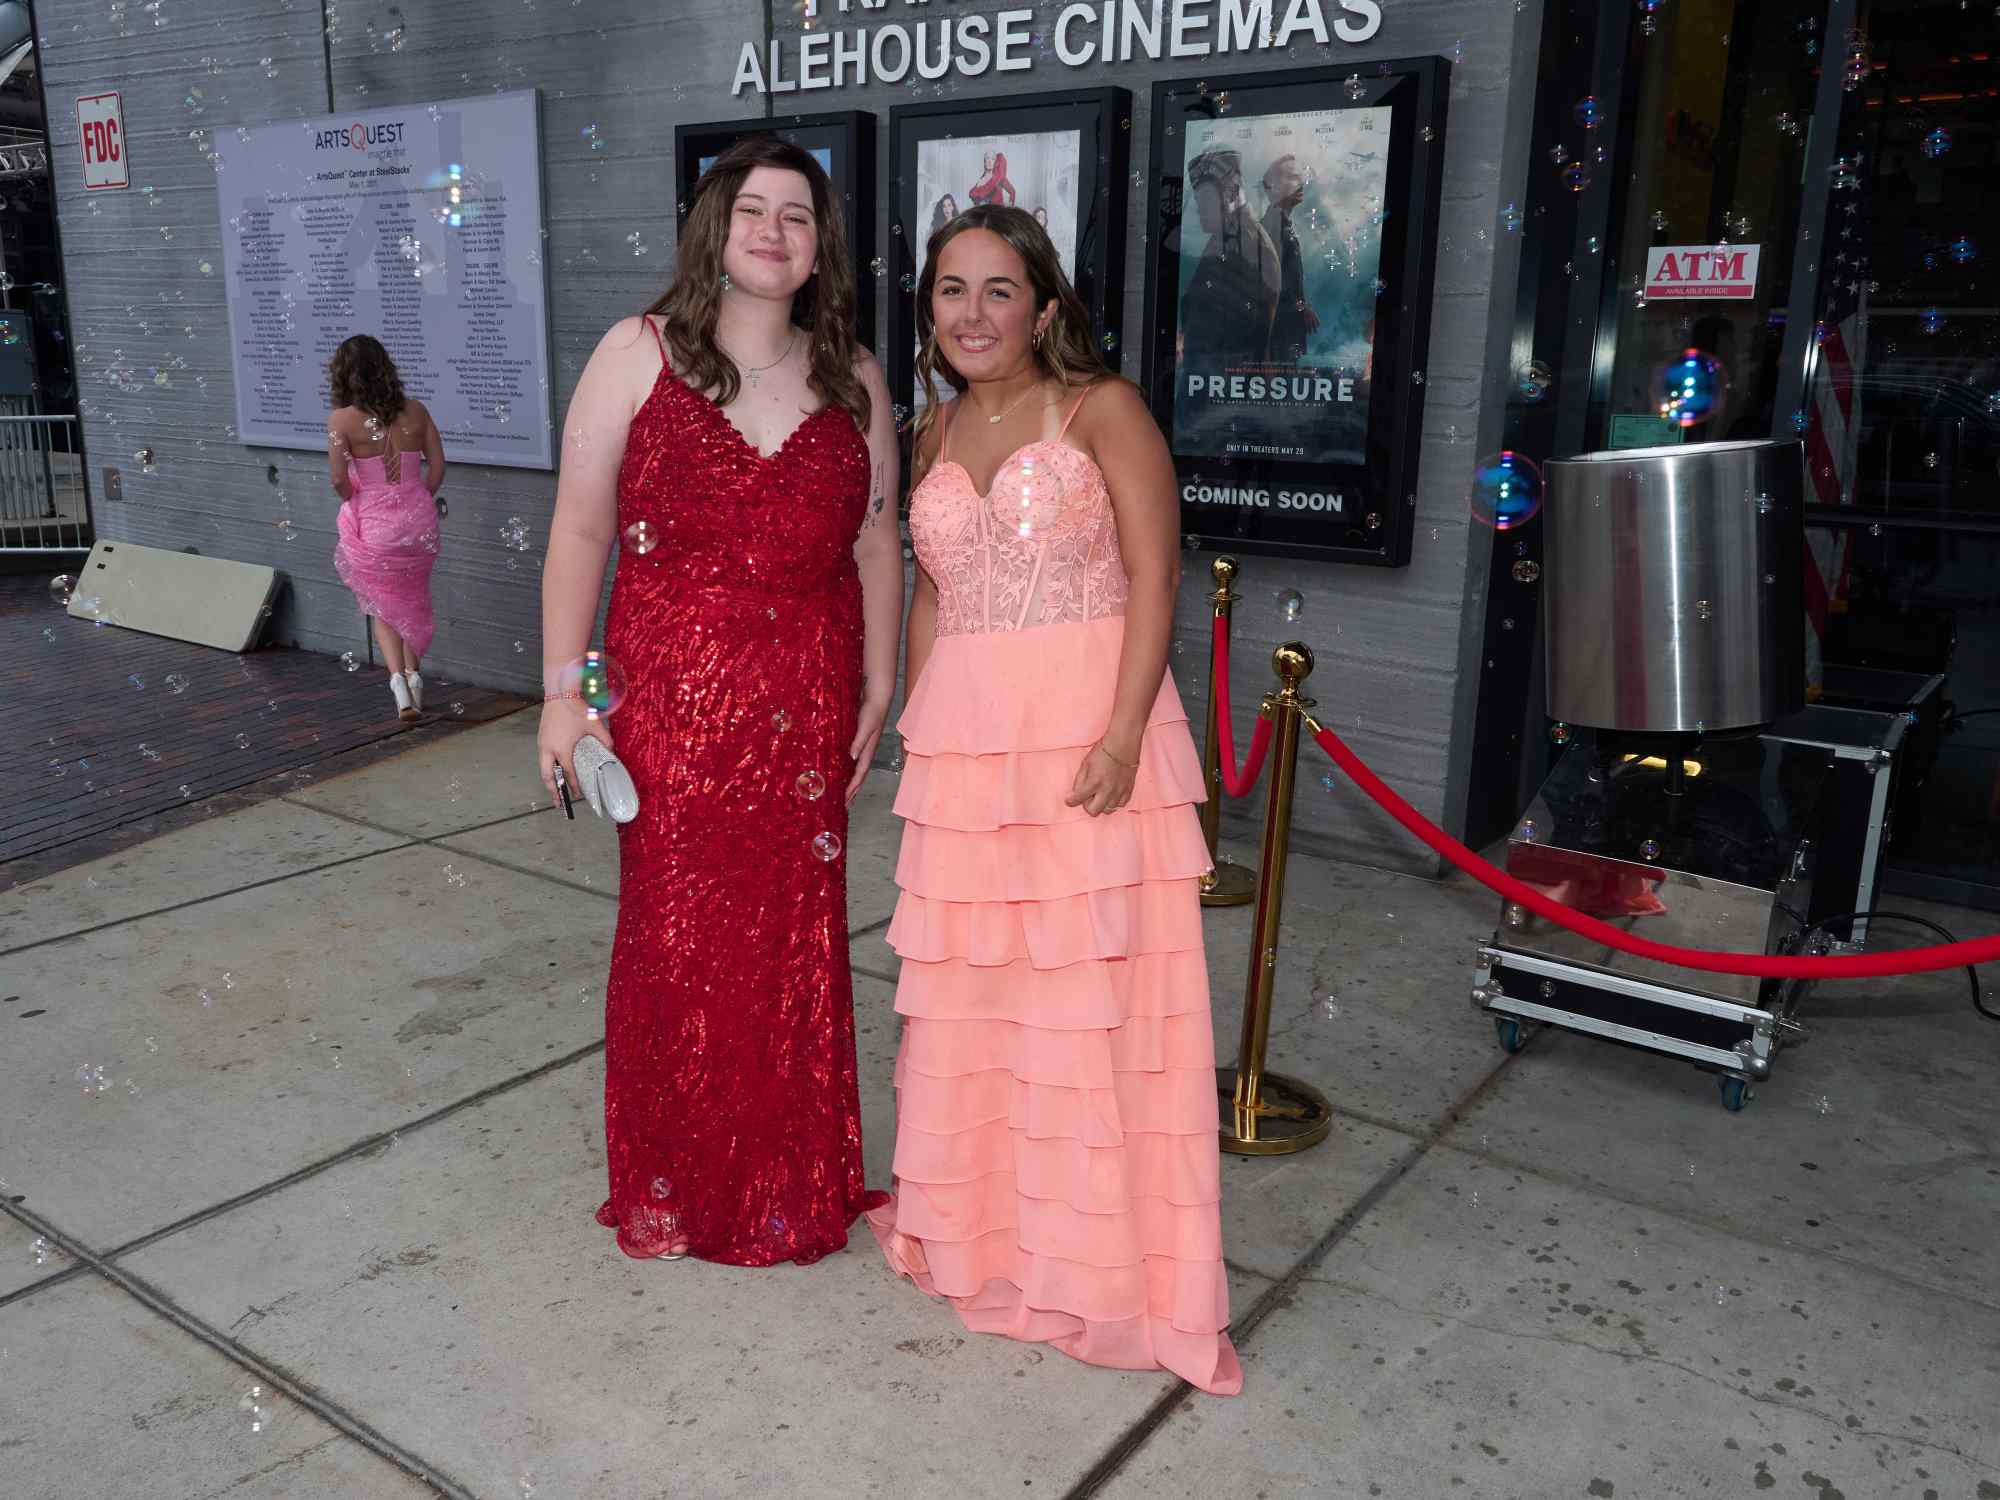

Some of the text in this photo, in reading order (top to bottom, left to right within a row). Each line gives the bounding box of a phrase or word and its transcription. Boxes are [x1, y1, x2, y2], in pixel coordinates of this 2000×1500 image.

[732, 0, 1383, 96] ALEHOUSE CINEMAS
[83, 118, 120, 164] FDC
[315, 122, 405, 151] ARTSQUEST
[1653, 251, 1749, 281] ATM
[1187, 374, 1354, 402] PRESSURE
[1281, 446, 1293, 455] MAY
[1182, 485, 1343, 513] COMING SOON
